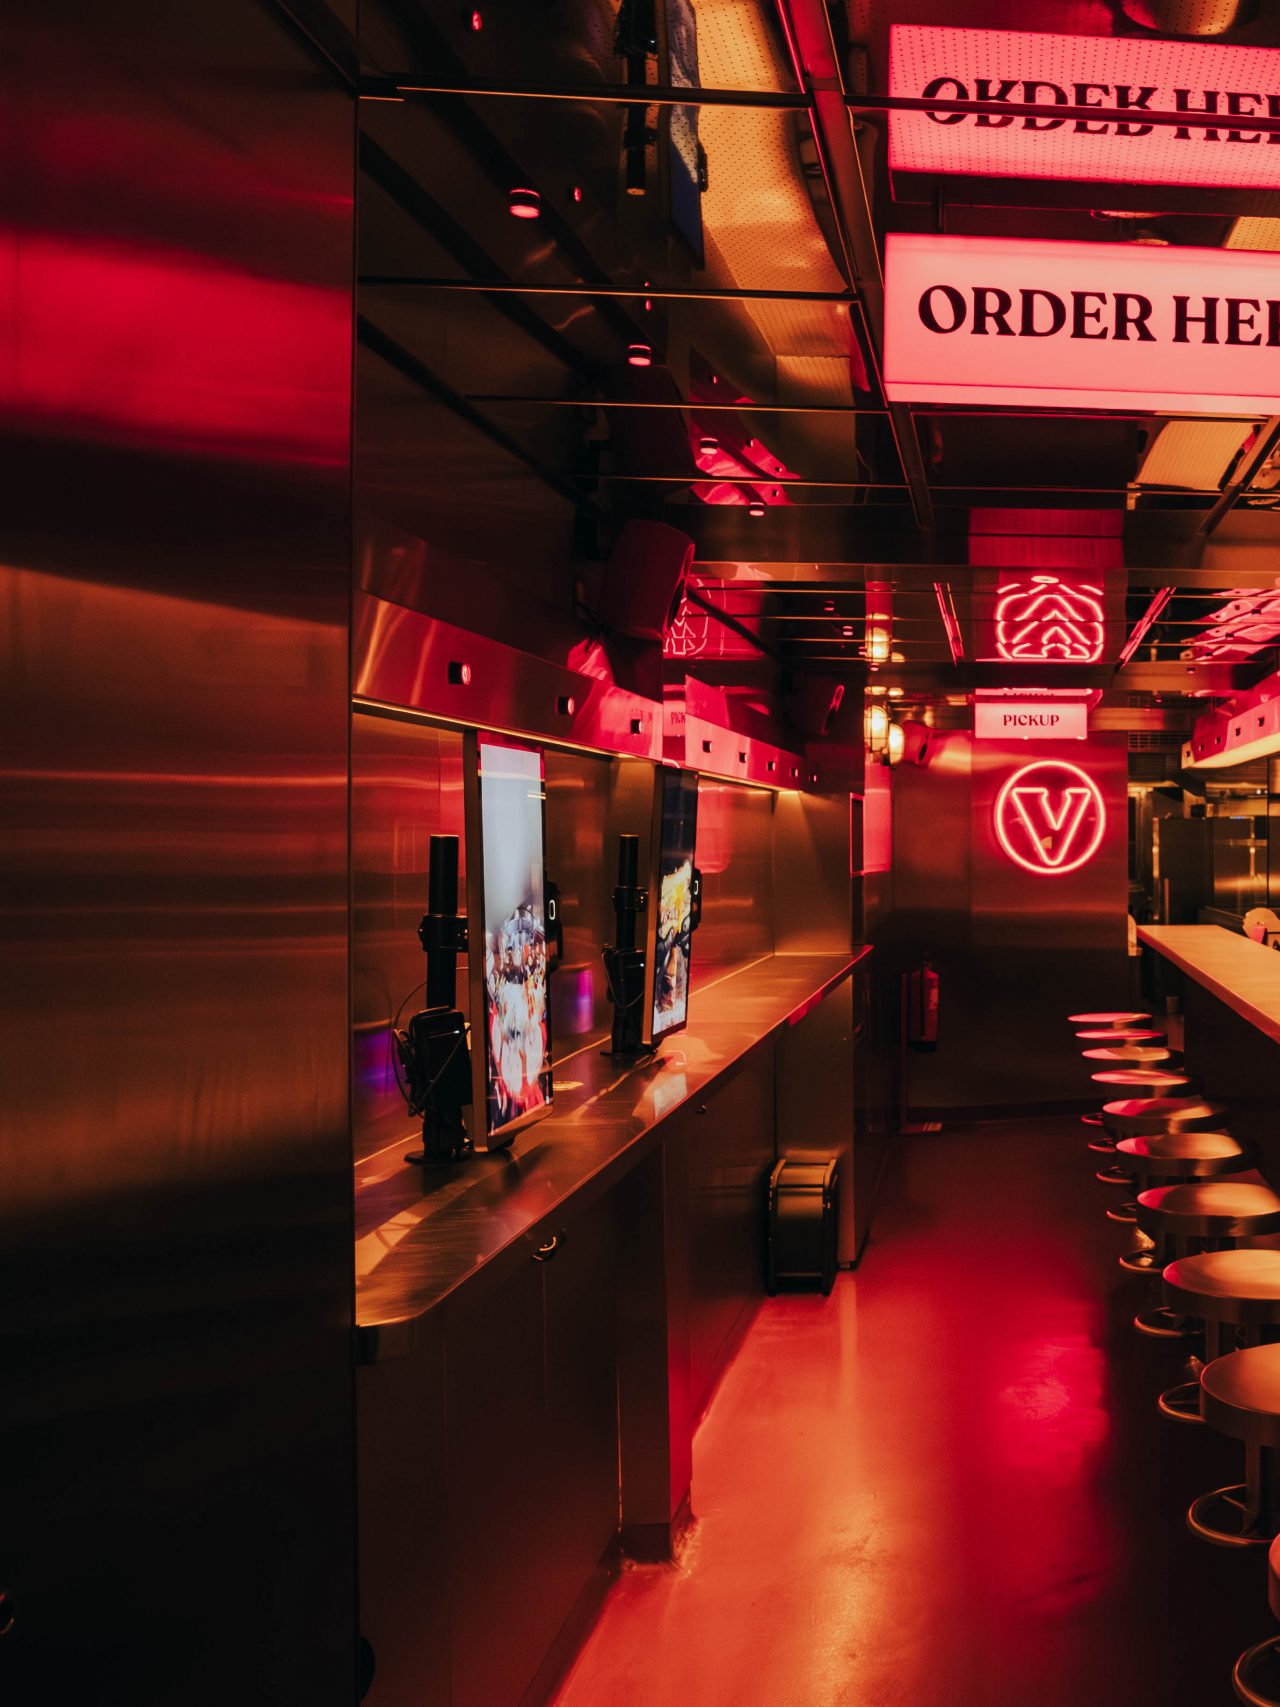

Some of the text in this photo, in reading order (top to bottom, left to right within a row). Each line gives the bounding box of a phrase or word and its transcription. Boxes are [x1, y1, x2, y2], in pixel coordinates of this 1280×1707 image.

[918, 285, 1157, 342] ORDER
[1003, 714, 1060, 726] PICKUP
[1011, 786, 1092, 867] V
